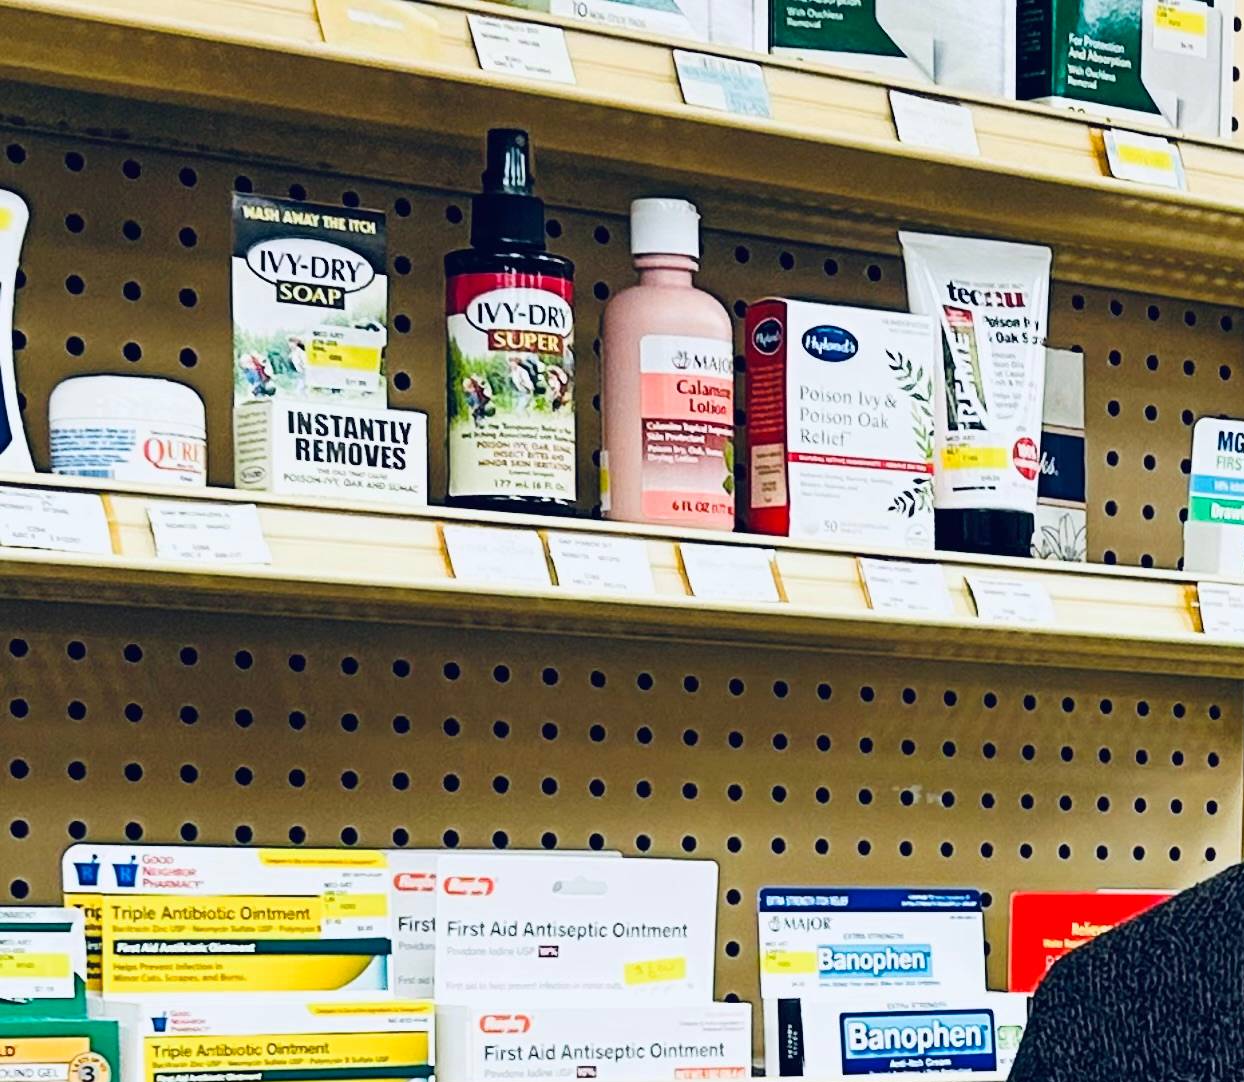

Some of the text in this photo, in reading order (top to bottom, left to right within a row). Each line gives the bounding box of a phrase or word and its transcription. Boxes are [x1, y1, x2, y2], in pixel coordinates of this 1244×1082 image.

[243, 205, 376, 235] WASH AWAY THE ITCH
[259, 250, 365, 284] IVY-DRY
[279, 282, 343, 306] SOAP
[477, 302, 568, 329] IVY-DRY
[493, 331, 561, 351] SUPER
[804, 335, 857, 356] Hyland's
[689, 398, 728, 415] Lotion
[799, 386, 897, 411] Poison Ivy &
[799, 406, 890, 429] Poison Oak
[288, 411, 412, 446] INSTANTLY
[799, 428, 846, 447] Relief
[295, 438, 407, 471] REMOVES
[681, 501, 693, 512] FL
[695, 501, 710, 513] OZ
[111, 904, 311, 922] Triple Antibiotic Ointment
[398, 916, 436, 933] First
[447, 920, 689, 941] First Aid Antiseptic Ointment
[782, 916, 833, 934] MAJOR
[112, 962, 138, 973] Helps
[139, 962, 174, 972] Prevent
[175, 962, 214, 972] Infection
[818, 946, 927, 978] Banophen
[851, 1020, 983, 1054] Banophen
[152, 1043, 330, 1058] Triple Antibiotic Ointment
[484, 1042, 725, 1063] First Aid Antiseptic Ointment
